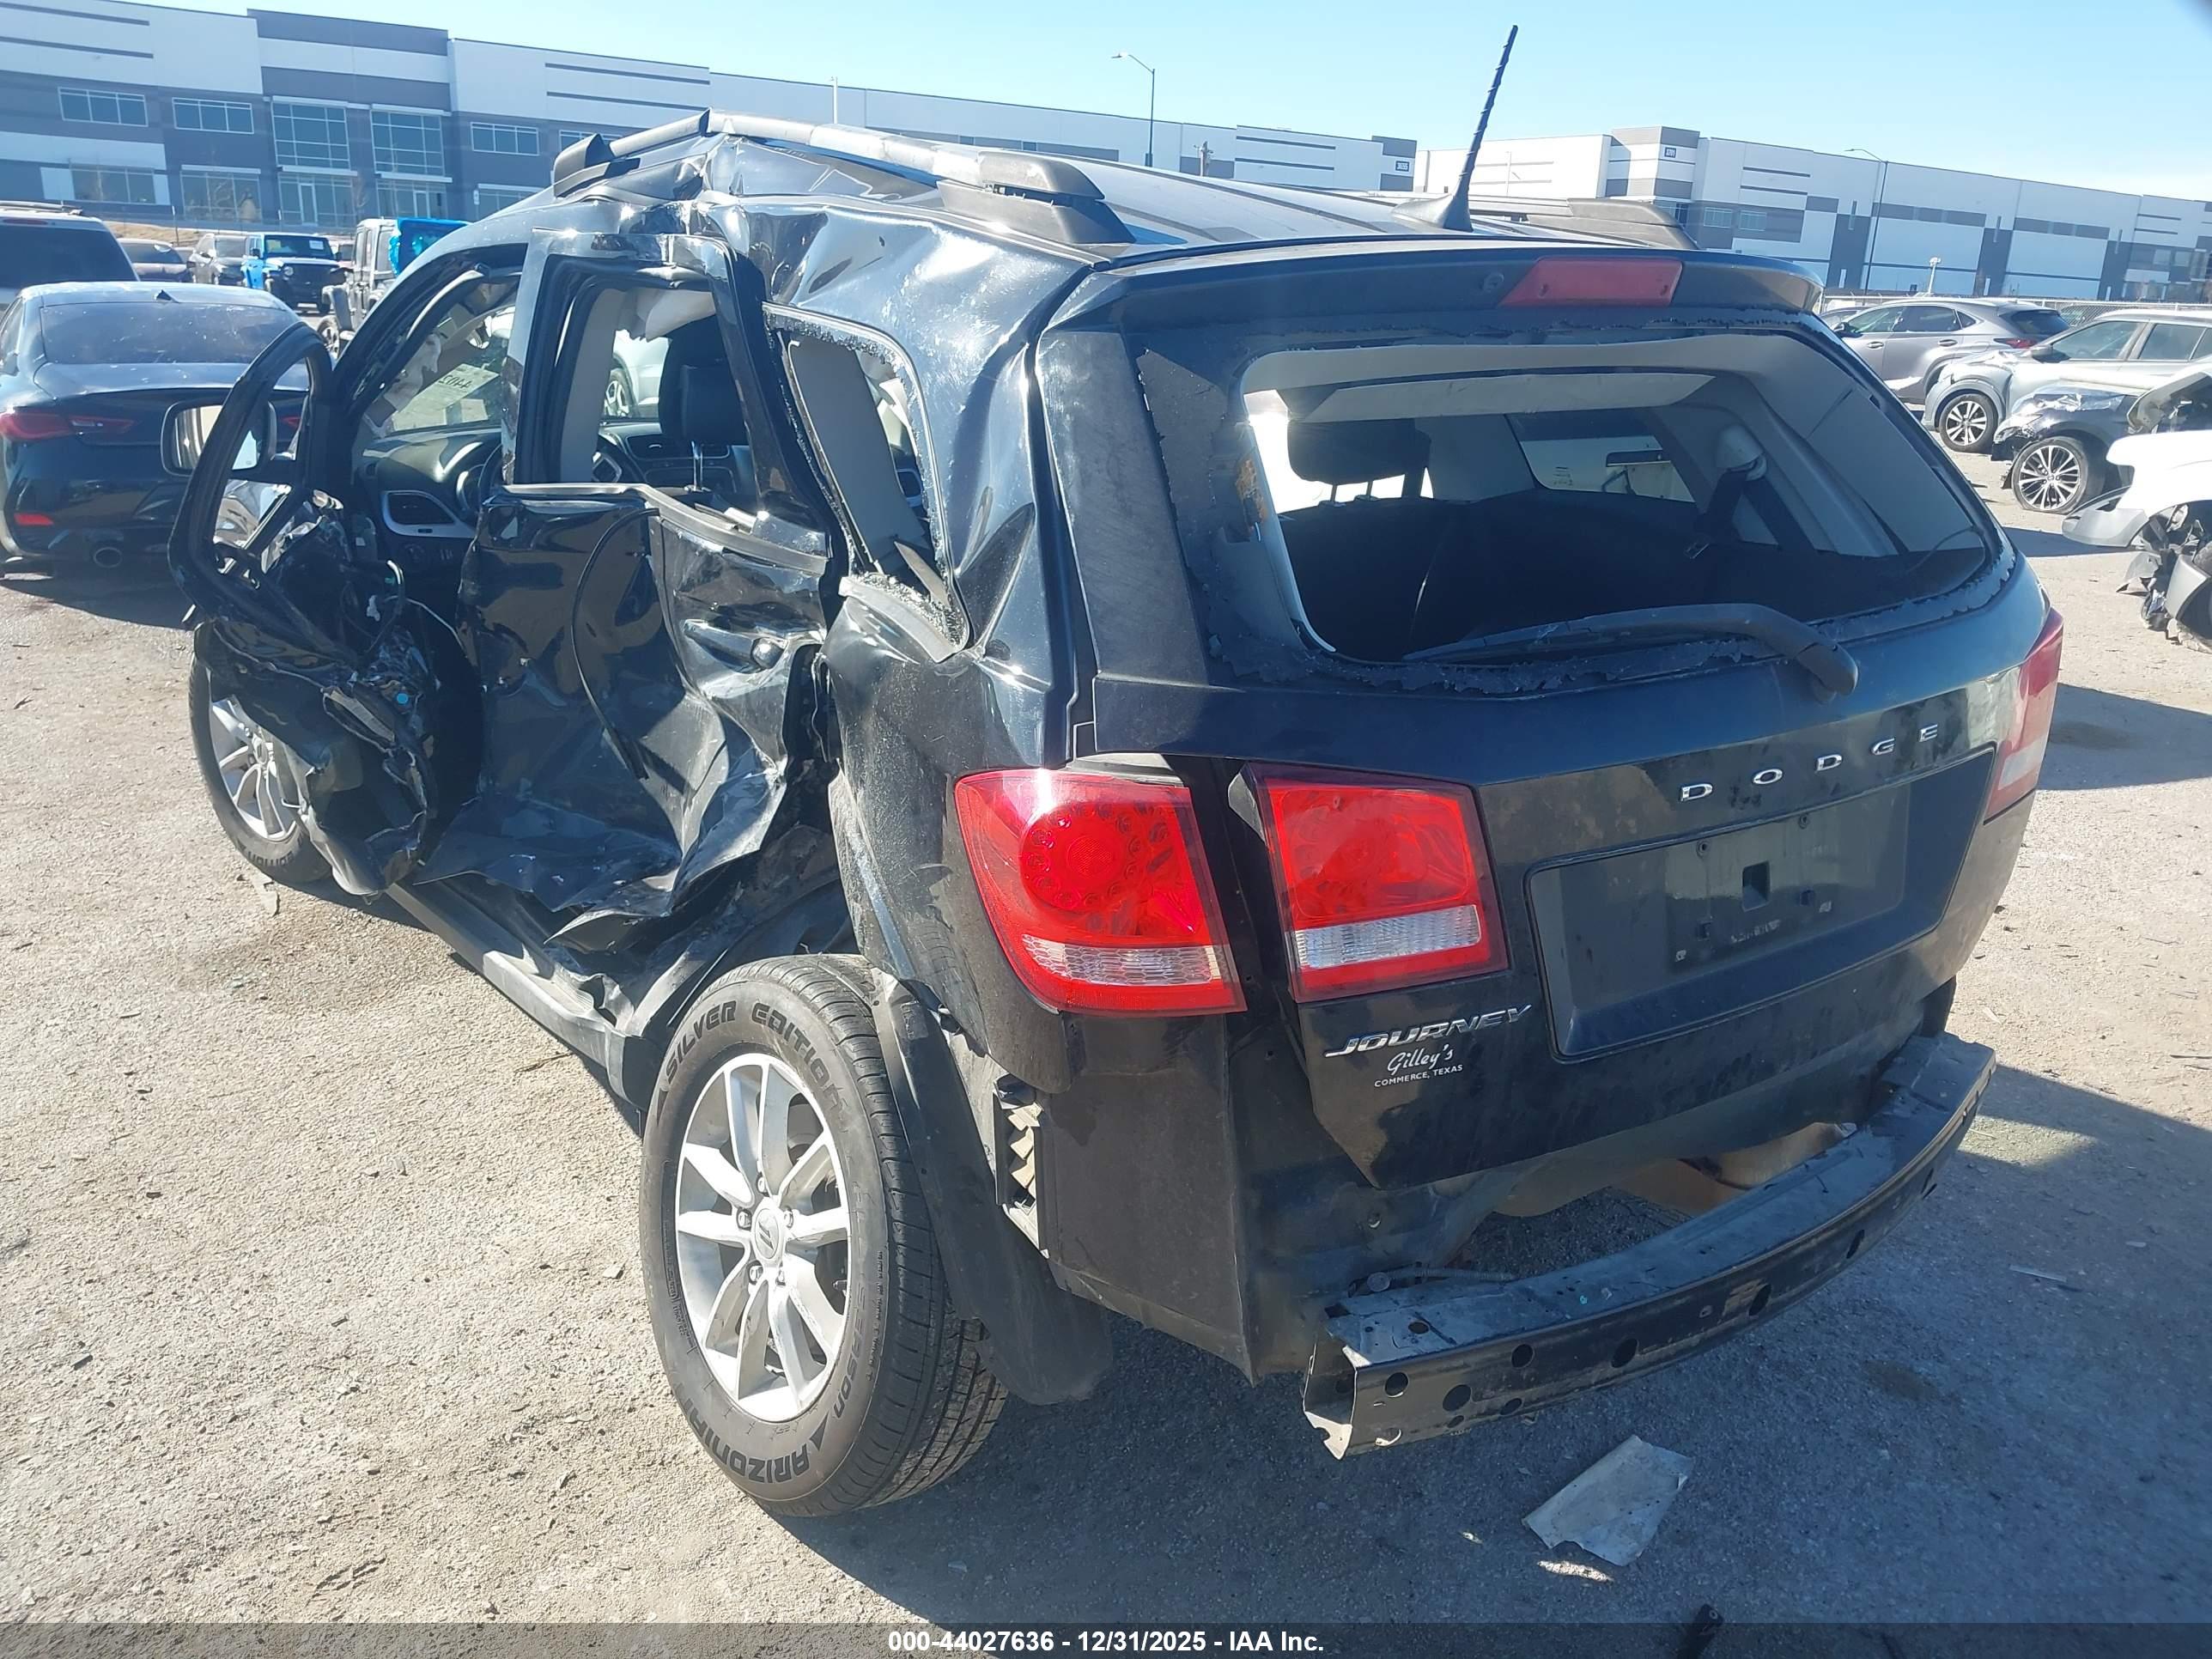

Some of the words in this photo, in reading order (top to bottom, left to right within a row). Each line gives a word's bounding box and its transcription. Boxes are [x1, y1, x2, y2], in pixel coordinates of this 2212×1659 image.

[1680, 724, 1939, 802] DODGE
[665, 1000, 738, 1085] SILVER
[751, 1001, 839, 1110] EDITION
[1325, 1004, 1532, 1058] JOURNEY
[1374, 1072, 1431, 1088] COMMERCE,
[1433, 1064, 1464, 1078] TEXAS
[1387, 1043, 1455, 1076] Gilley's
